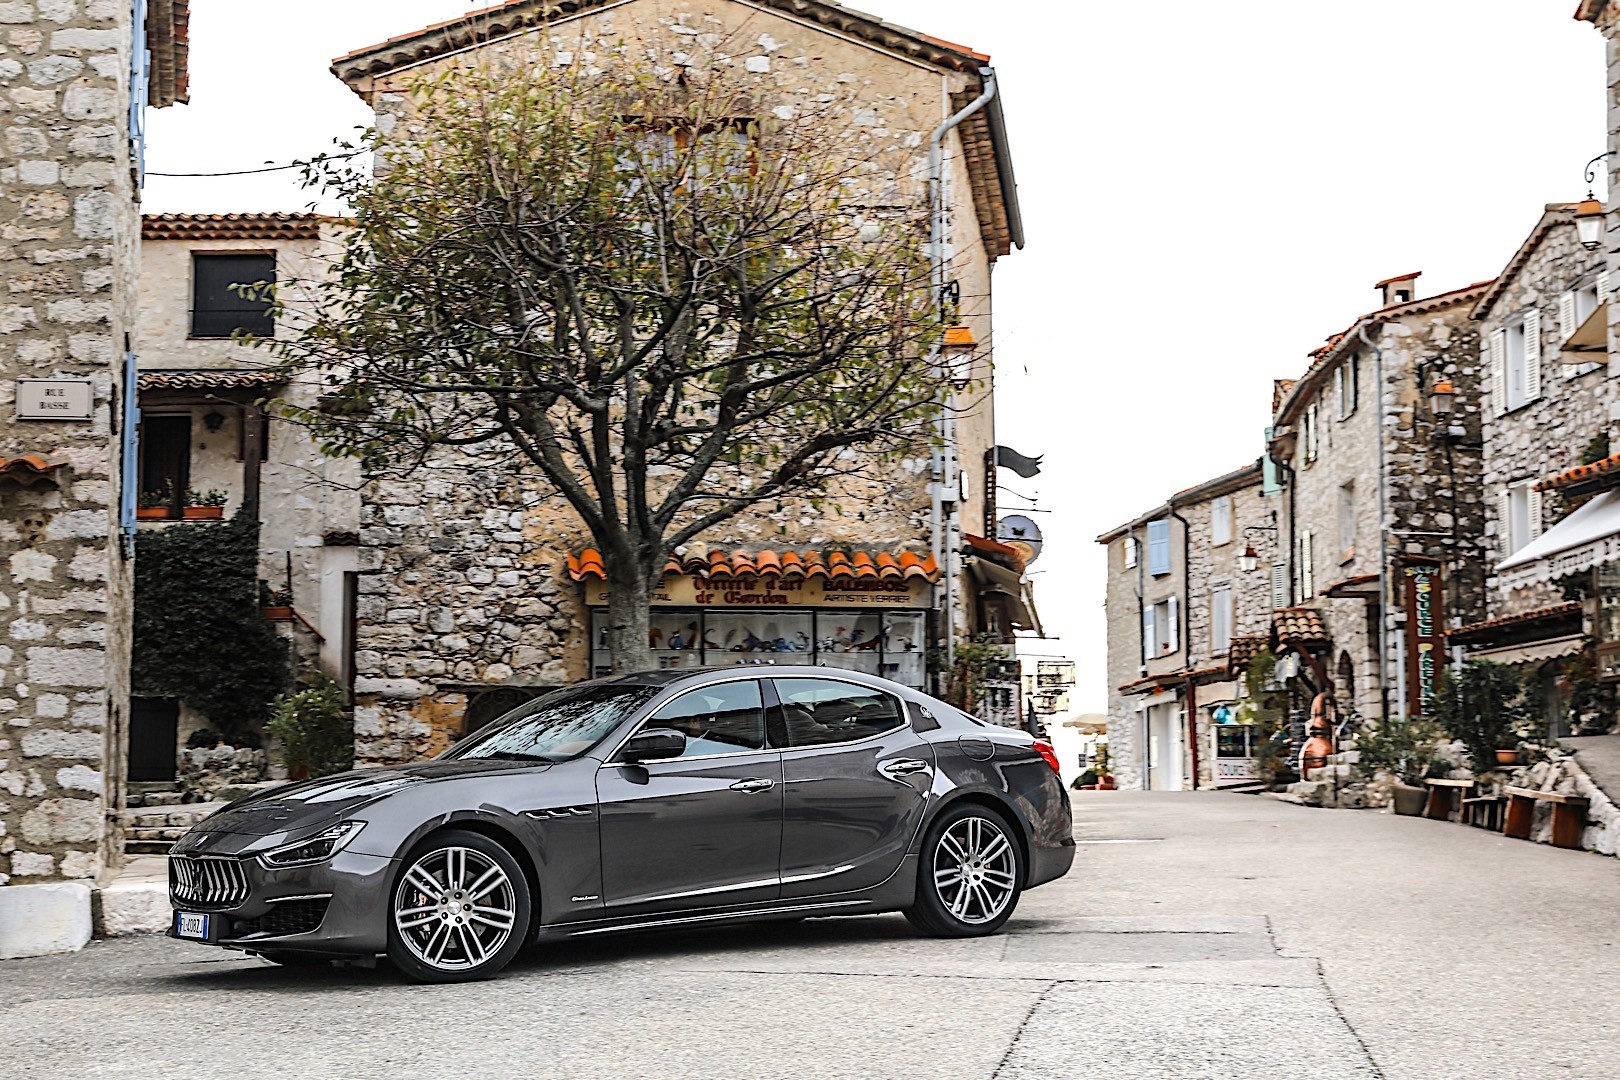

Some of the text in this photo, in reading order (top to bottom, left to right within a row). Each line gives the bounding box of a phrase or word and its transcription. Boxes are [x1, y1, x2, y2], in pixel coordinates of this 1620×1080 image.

[45, 388, 65, 396] RUE
[40, 401, 69, 409] BASSE
[695, 590, 789, 604] de Gourdon
[823, 594, 910, 603] ARTISTE VERRIER
[1416, 584, 1433, 637] SOURCE
